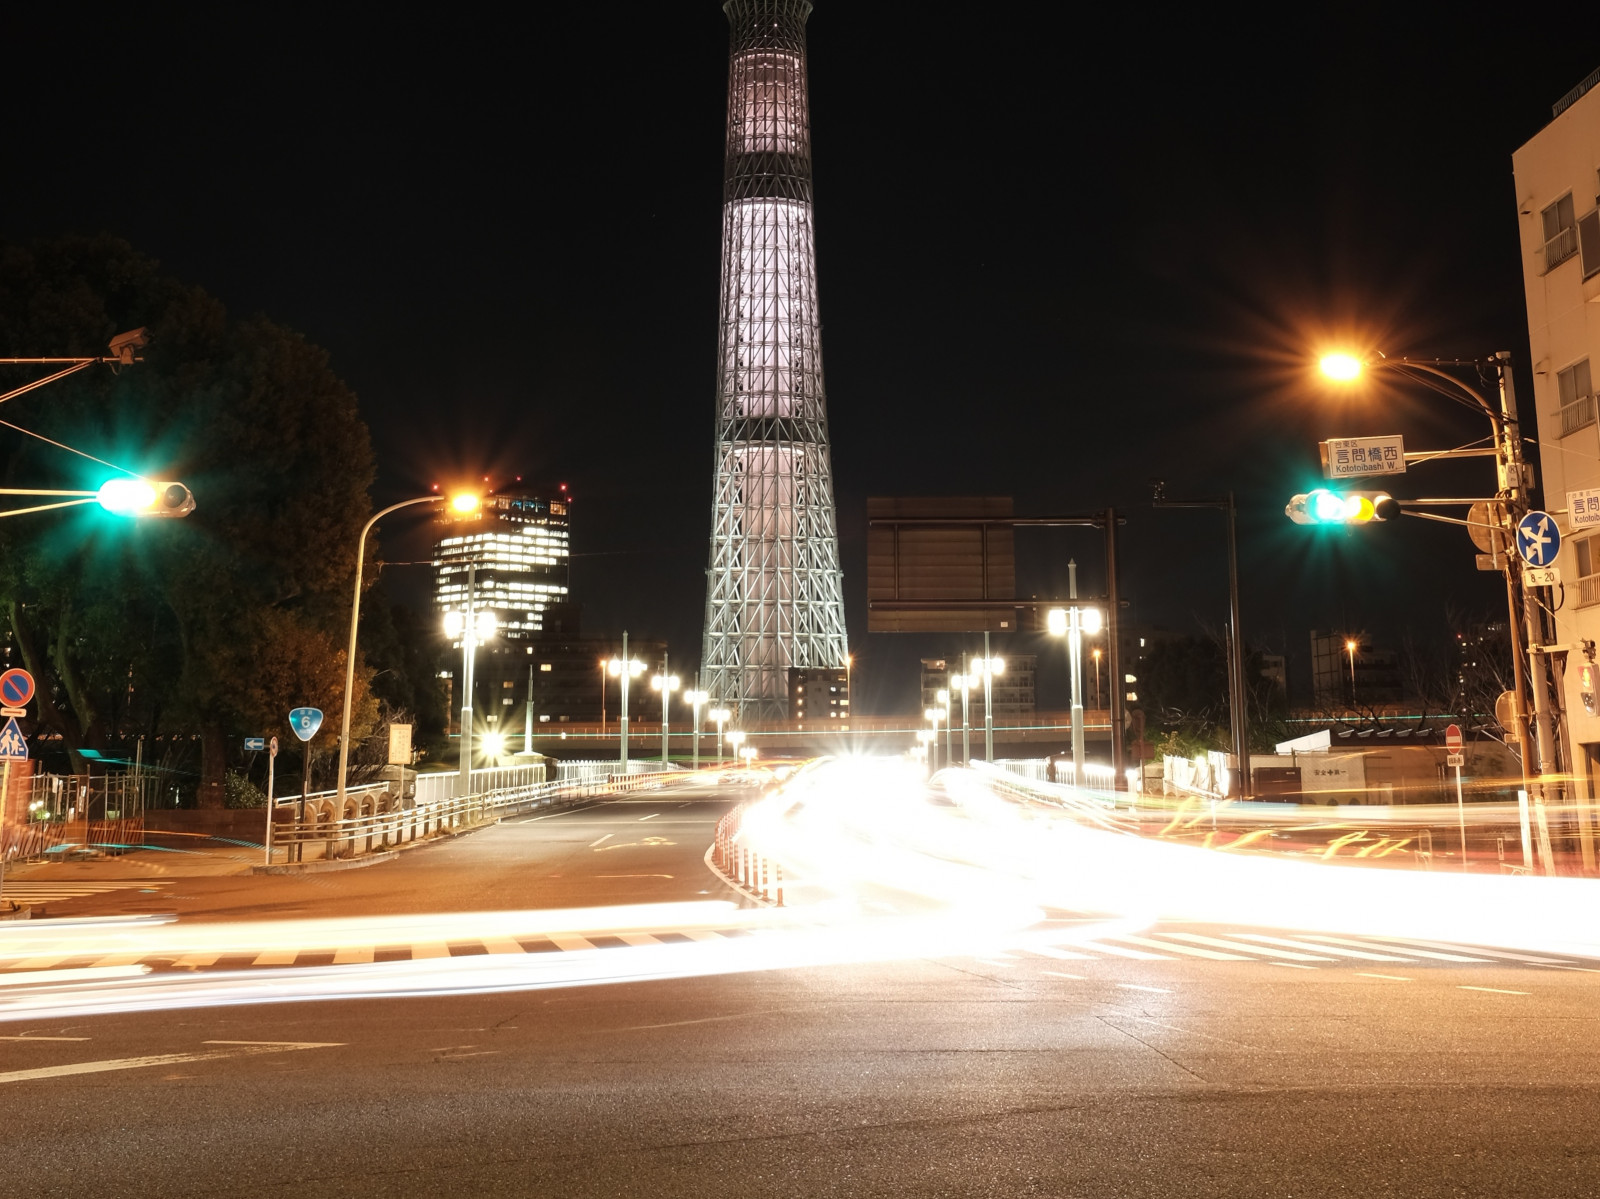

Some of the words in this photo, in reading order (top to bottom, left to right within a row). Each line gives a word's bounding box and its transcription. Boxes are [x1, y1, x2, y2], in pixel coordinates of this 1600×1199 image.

[1335, 446, 1398, 464] 言問橋西
[1336, 462, 1384, 473] Kototoibashi
[301, 716, 311, 728] 6
